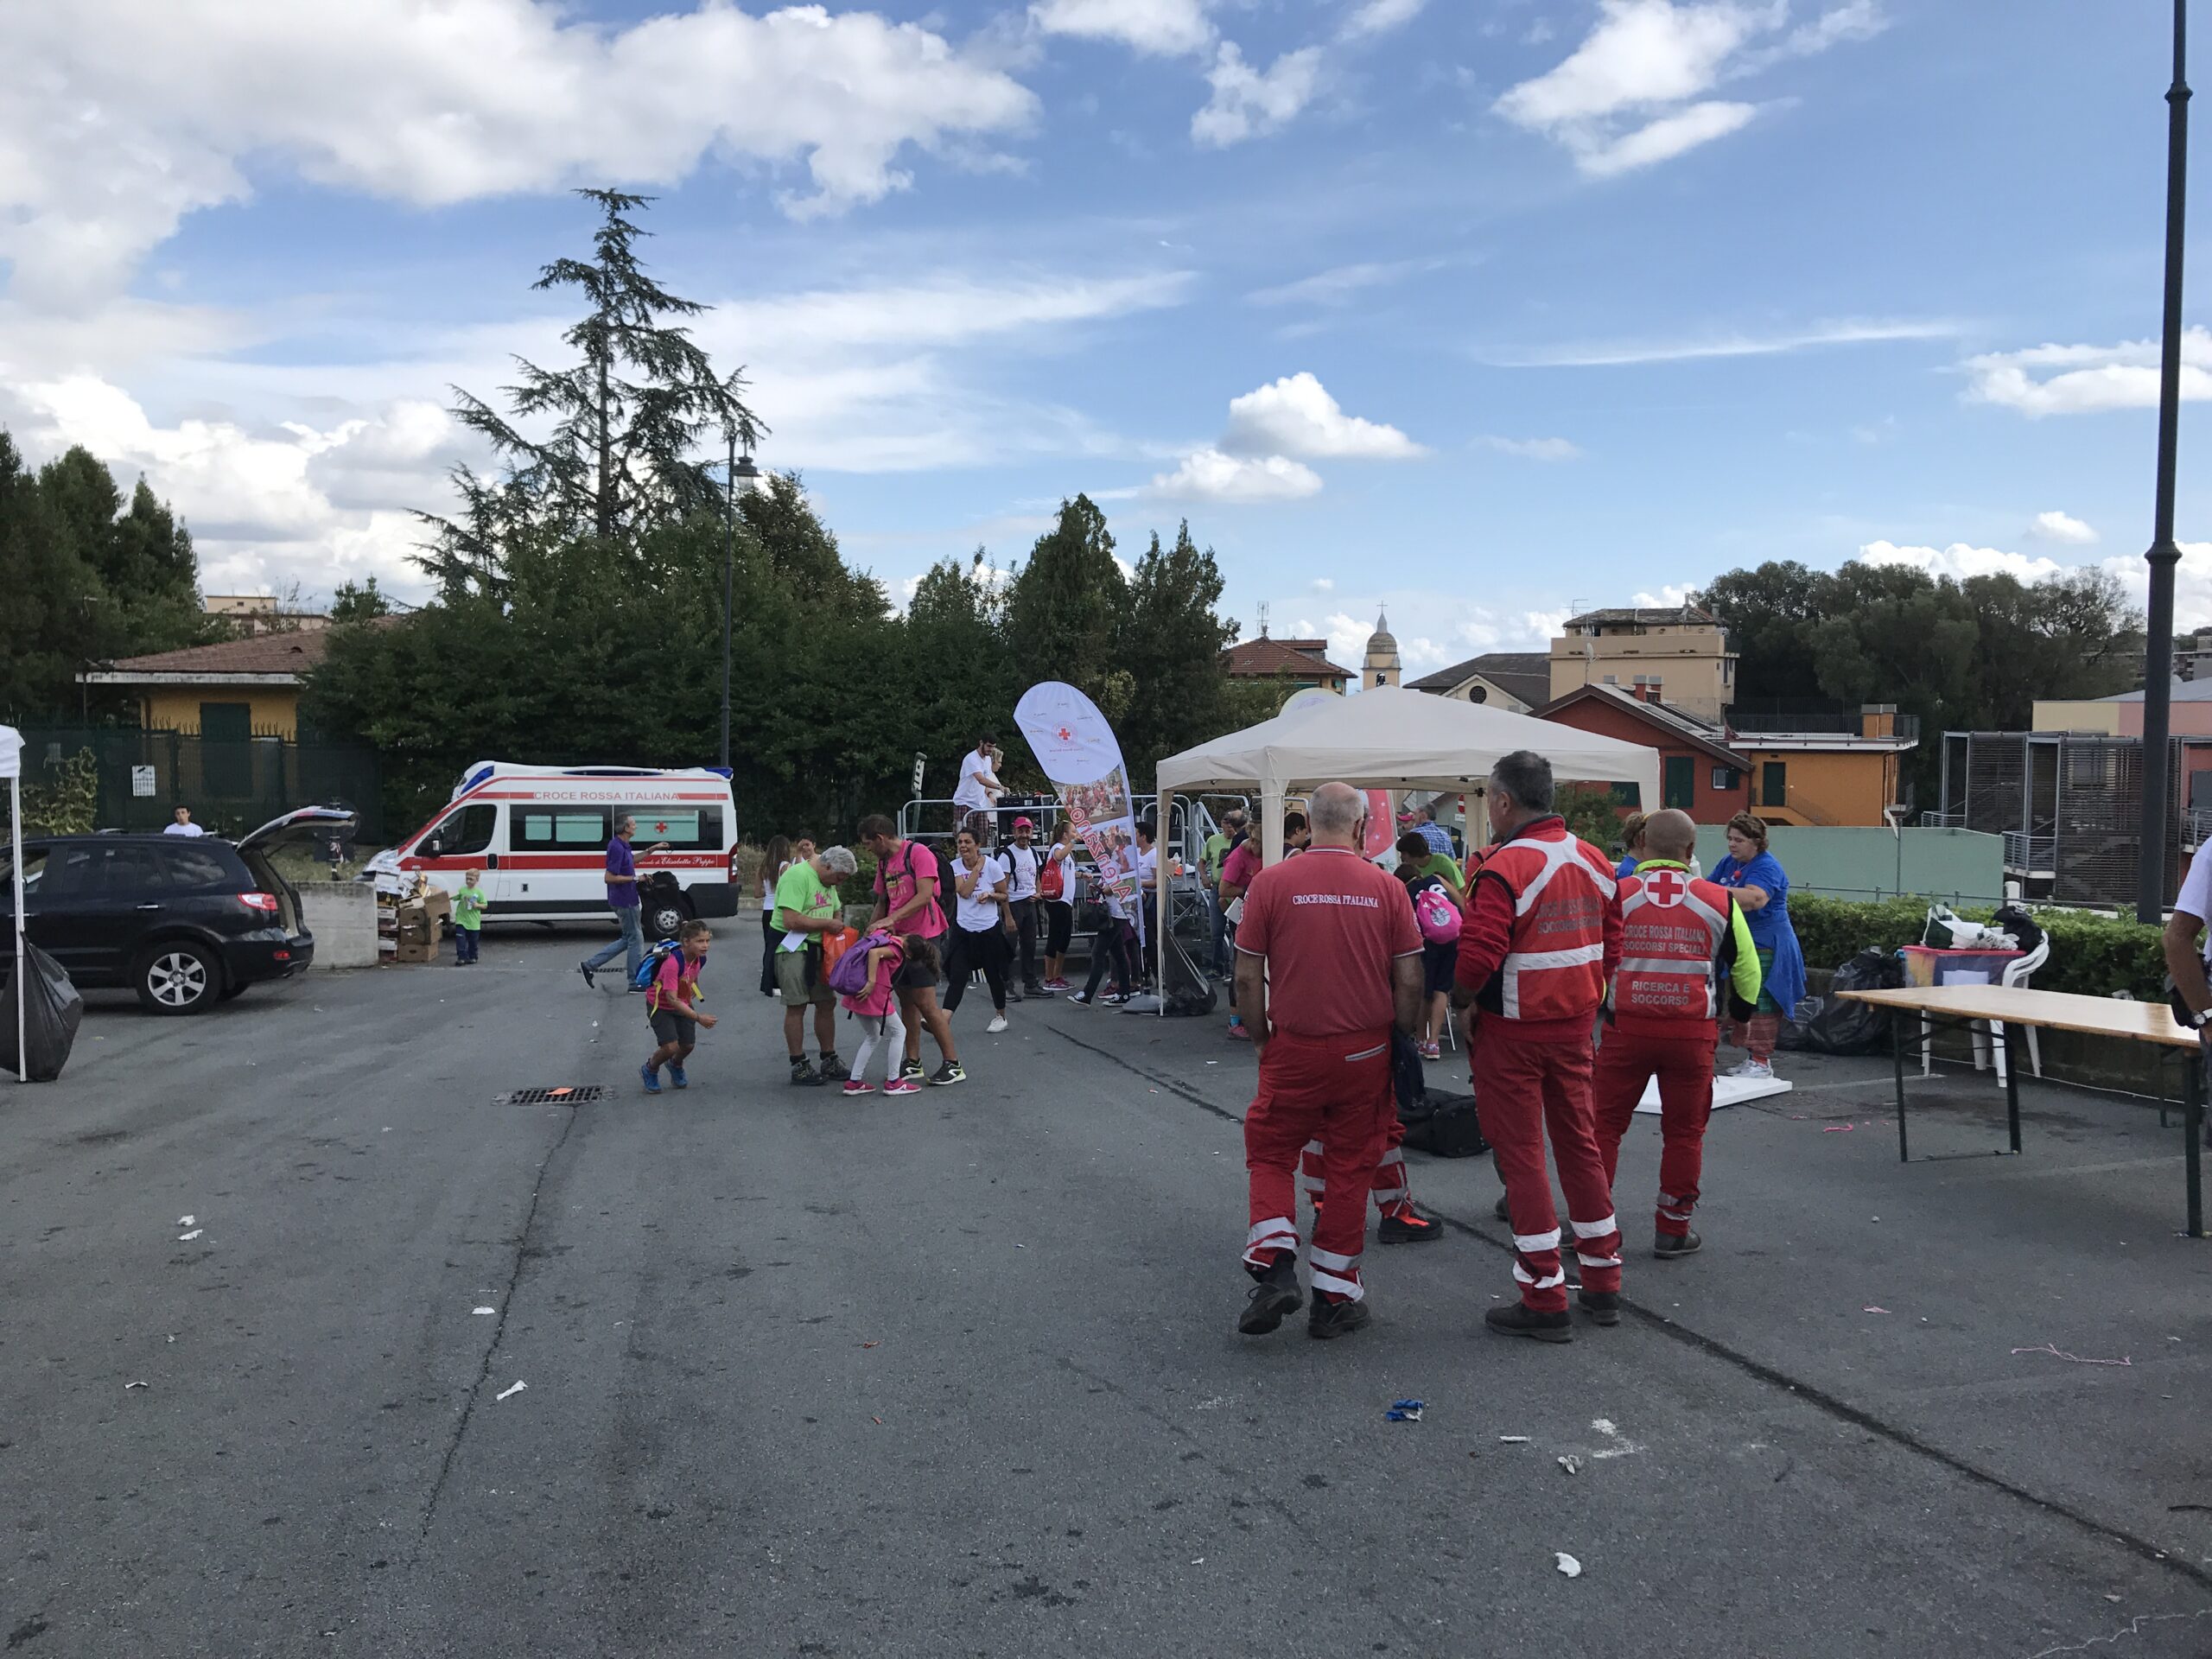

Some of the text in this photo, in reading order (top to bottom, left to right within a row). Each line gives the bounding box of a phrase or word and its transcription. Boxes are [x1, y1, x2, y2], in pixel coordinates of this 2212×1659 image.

[534, 791, 679, 800] CROCE ROSSA ITALIANA
[1293, 894, 1378, 907] CROCE ROSSA ITALIANA
[1624, 925, 1707, 943] CROCE ROSSA ITALIANA
[1624, 941, 1666, 951] SOCCORSI
[1632, 981, 1690, 993] RICERCA E
[1631, 994, 1689, 1005] SOCCORSO
